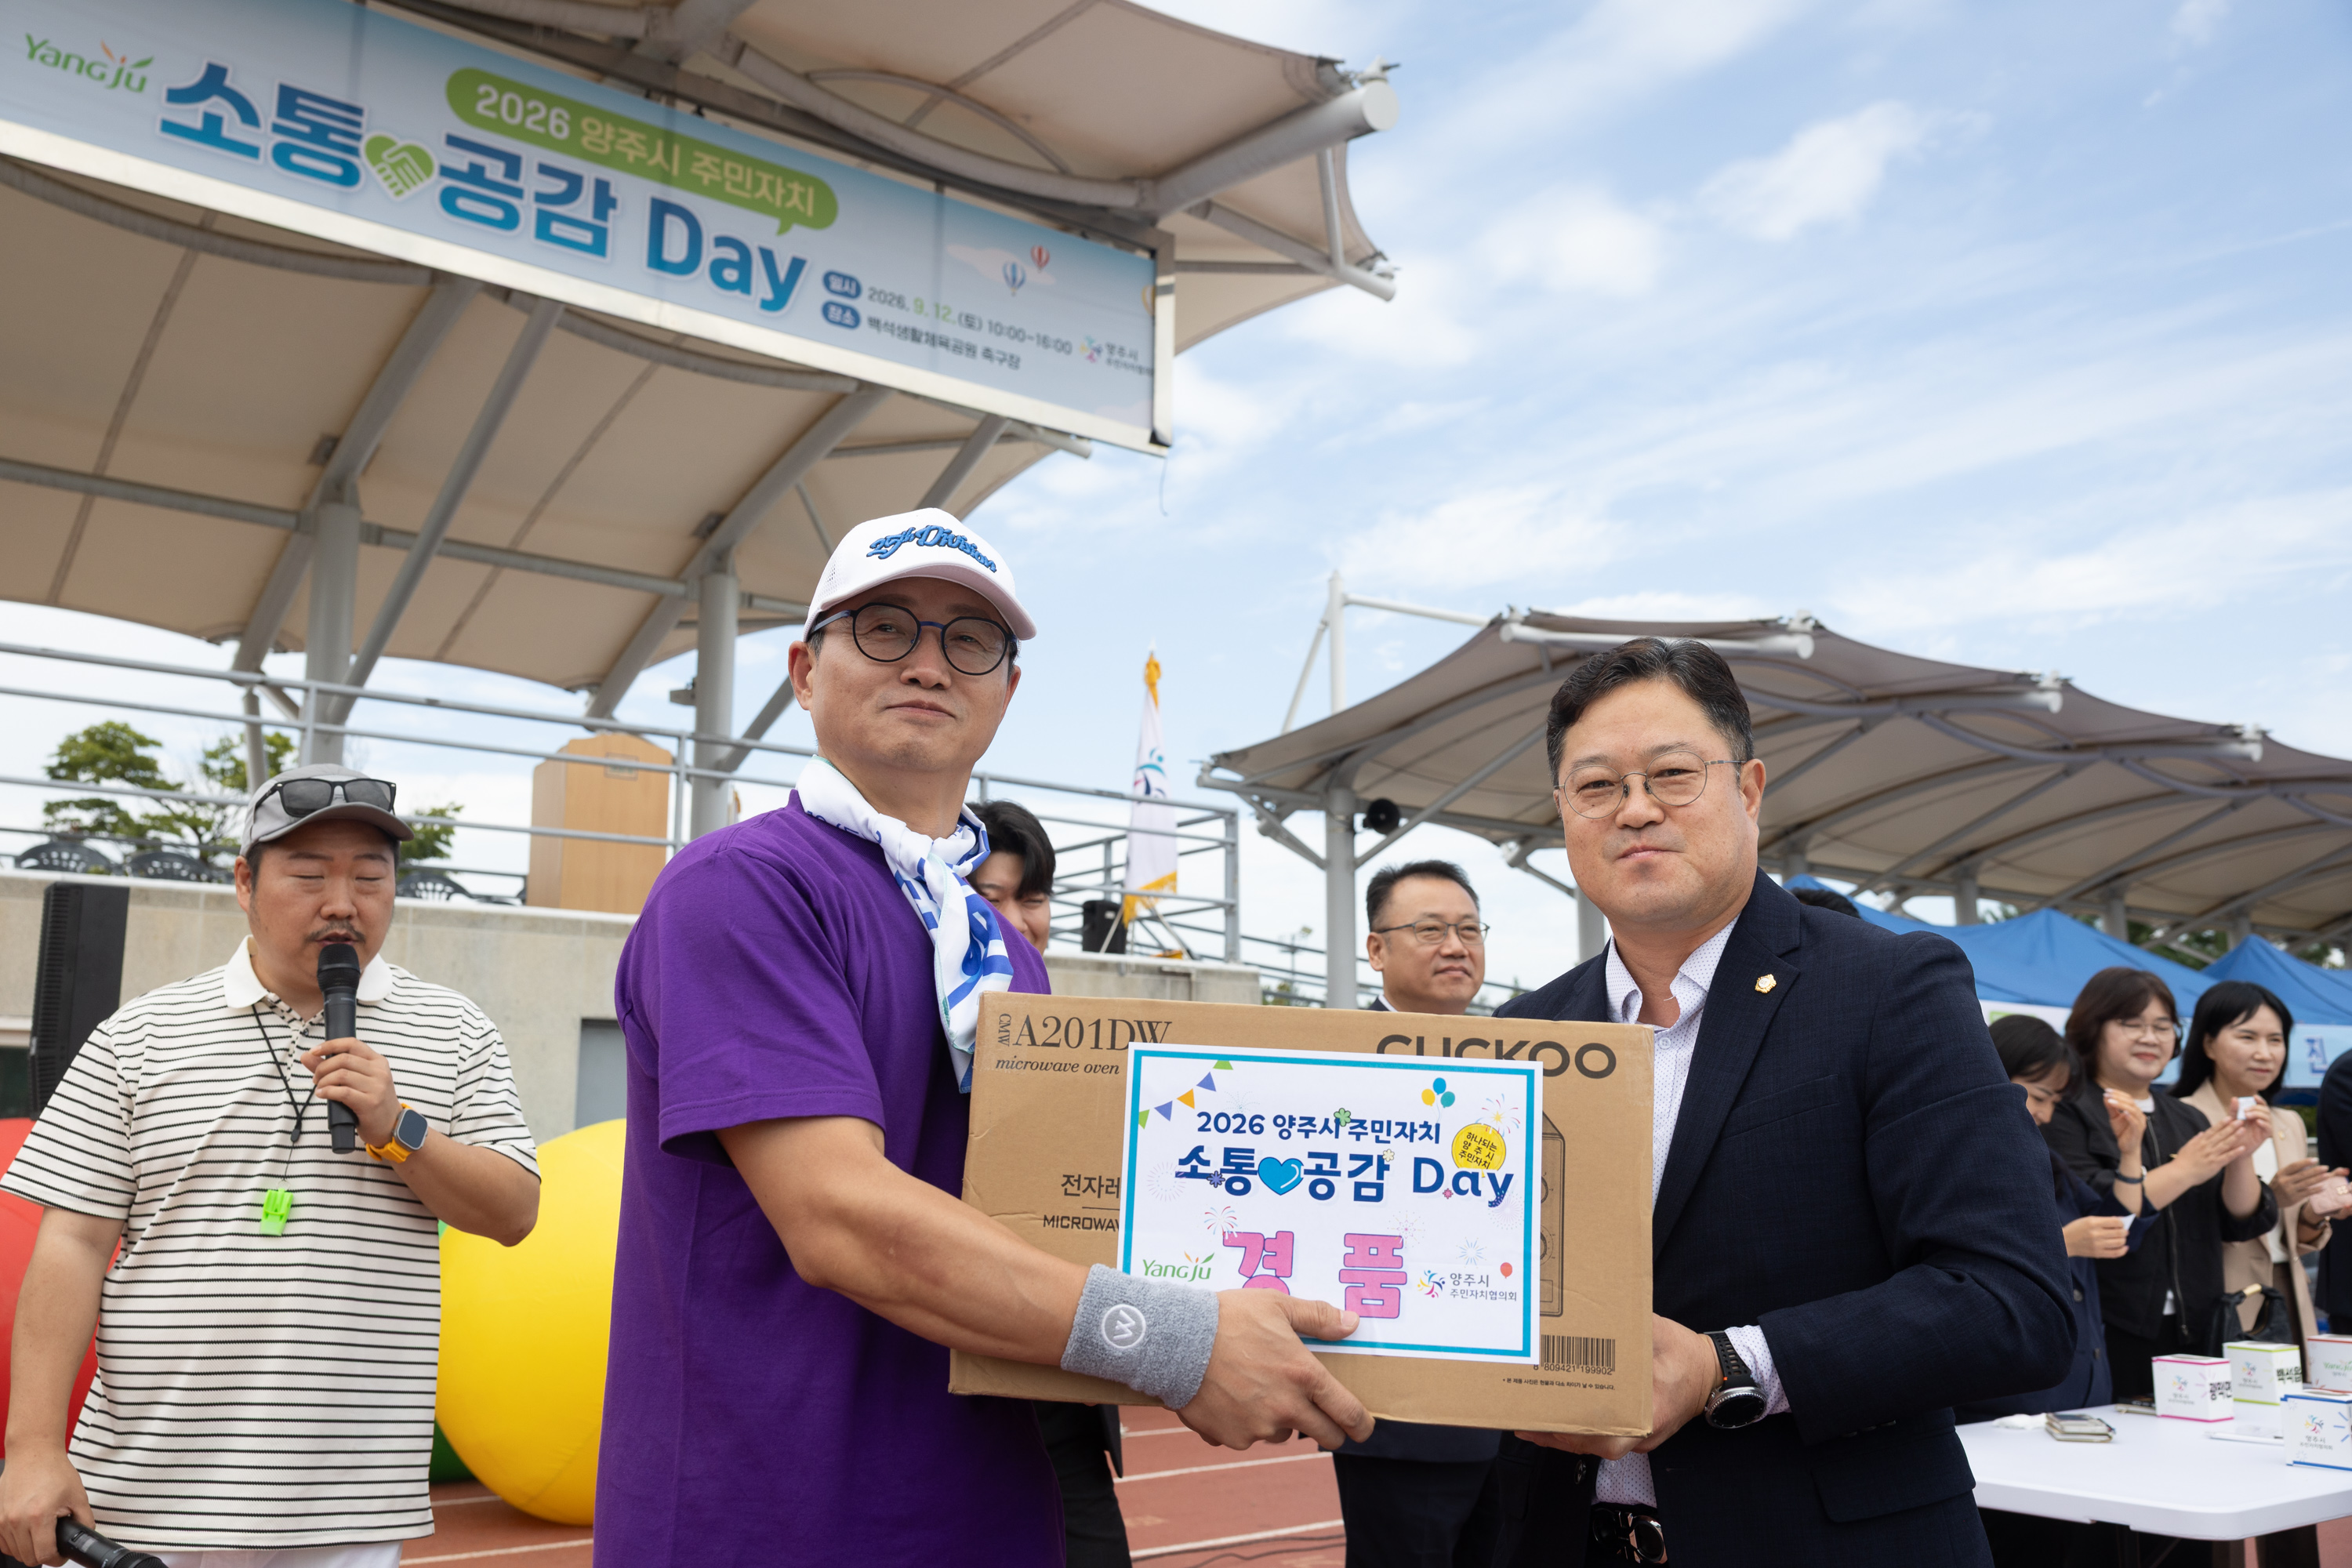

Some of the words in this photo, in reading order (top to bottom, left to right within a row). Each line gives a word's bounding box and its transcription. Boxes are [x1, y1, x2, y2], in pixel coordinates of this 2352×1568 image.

[476, 84, 571, 140] 2026
[581, 117, 681, 176] 양주시
[691, 151, 815, 217] 주민자치
[161, 62, 365, 187] 소통
[438, 132, 618, 258] 공감
[646, 197, 807, 312] Day
[829, 274, 856, 296] 일시
[868, 287, 909, 311] 2026.
[828, 304, 856, 326] 장소
[867, 317, 978, 359] 백석생활체육공원
[915, 525, 996, 572] Division
[997, 1013, 1011, 1047] CMW
[1012, 1014, 1172, 1051] A201DW
[995, 1055, 1080, 1073] microwave
[1083, 1062, 1120, 1075] oven
[1197, 1111, 1265, 1136] 2026
[1272, 1114, 1341, 1140] 양주시
[1348, 1118, 1441, 1145] 주민자치
[1467, 1132, 1497, 1152] 하나되는
[1459, 1149, 1490, 1170] 주민자치
[1176, 1145, 1258, 1196] 소통
[1303, 1151, 1391, 1203] 공감
[1413, 1156, 1514, 1207] Day
[1450, 1273, 1489, 1287] 양주시
[1450, 1289, 1517, 1301] 주민자치협의회
[1544, 1363, 1576, 1372] 809421
[1581, 1366, 1613, 1375] 199902
